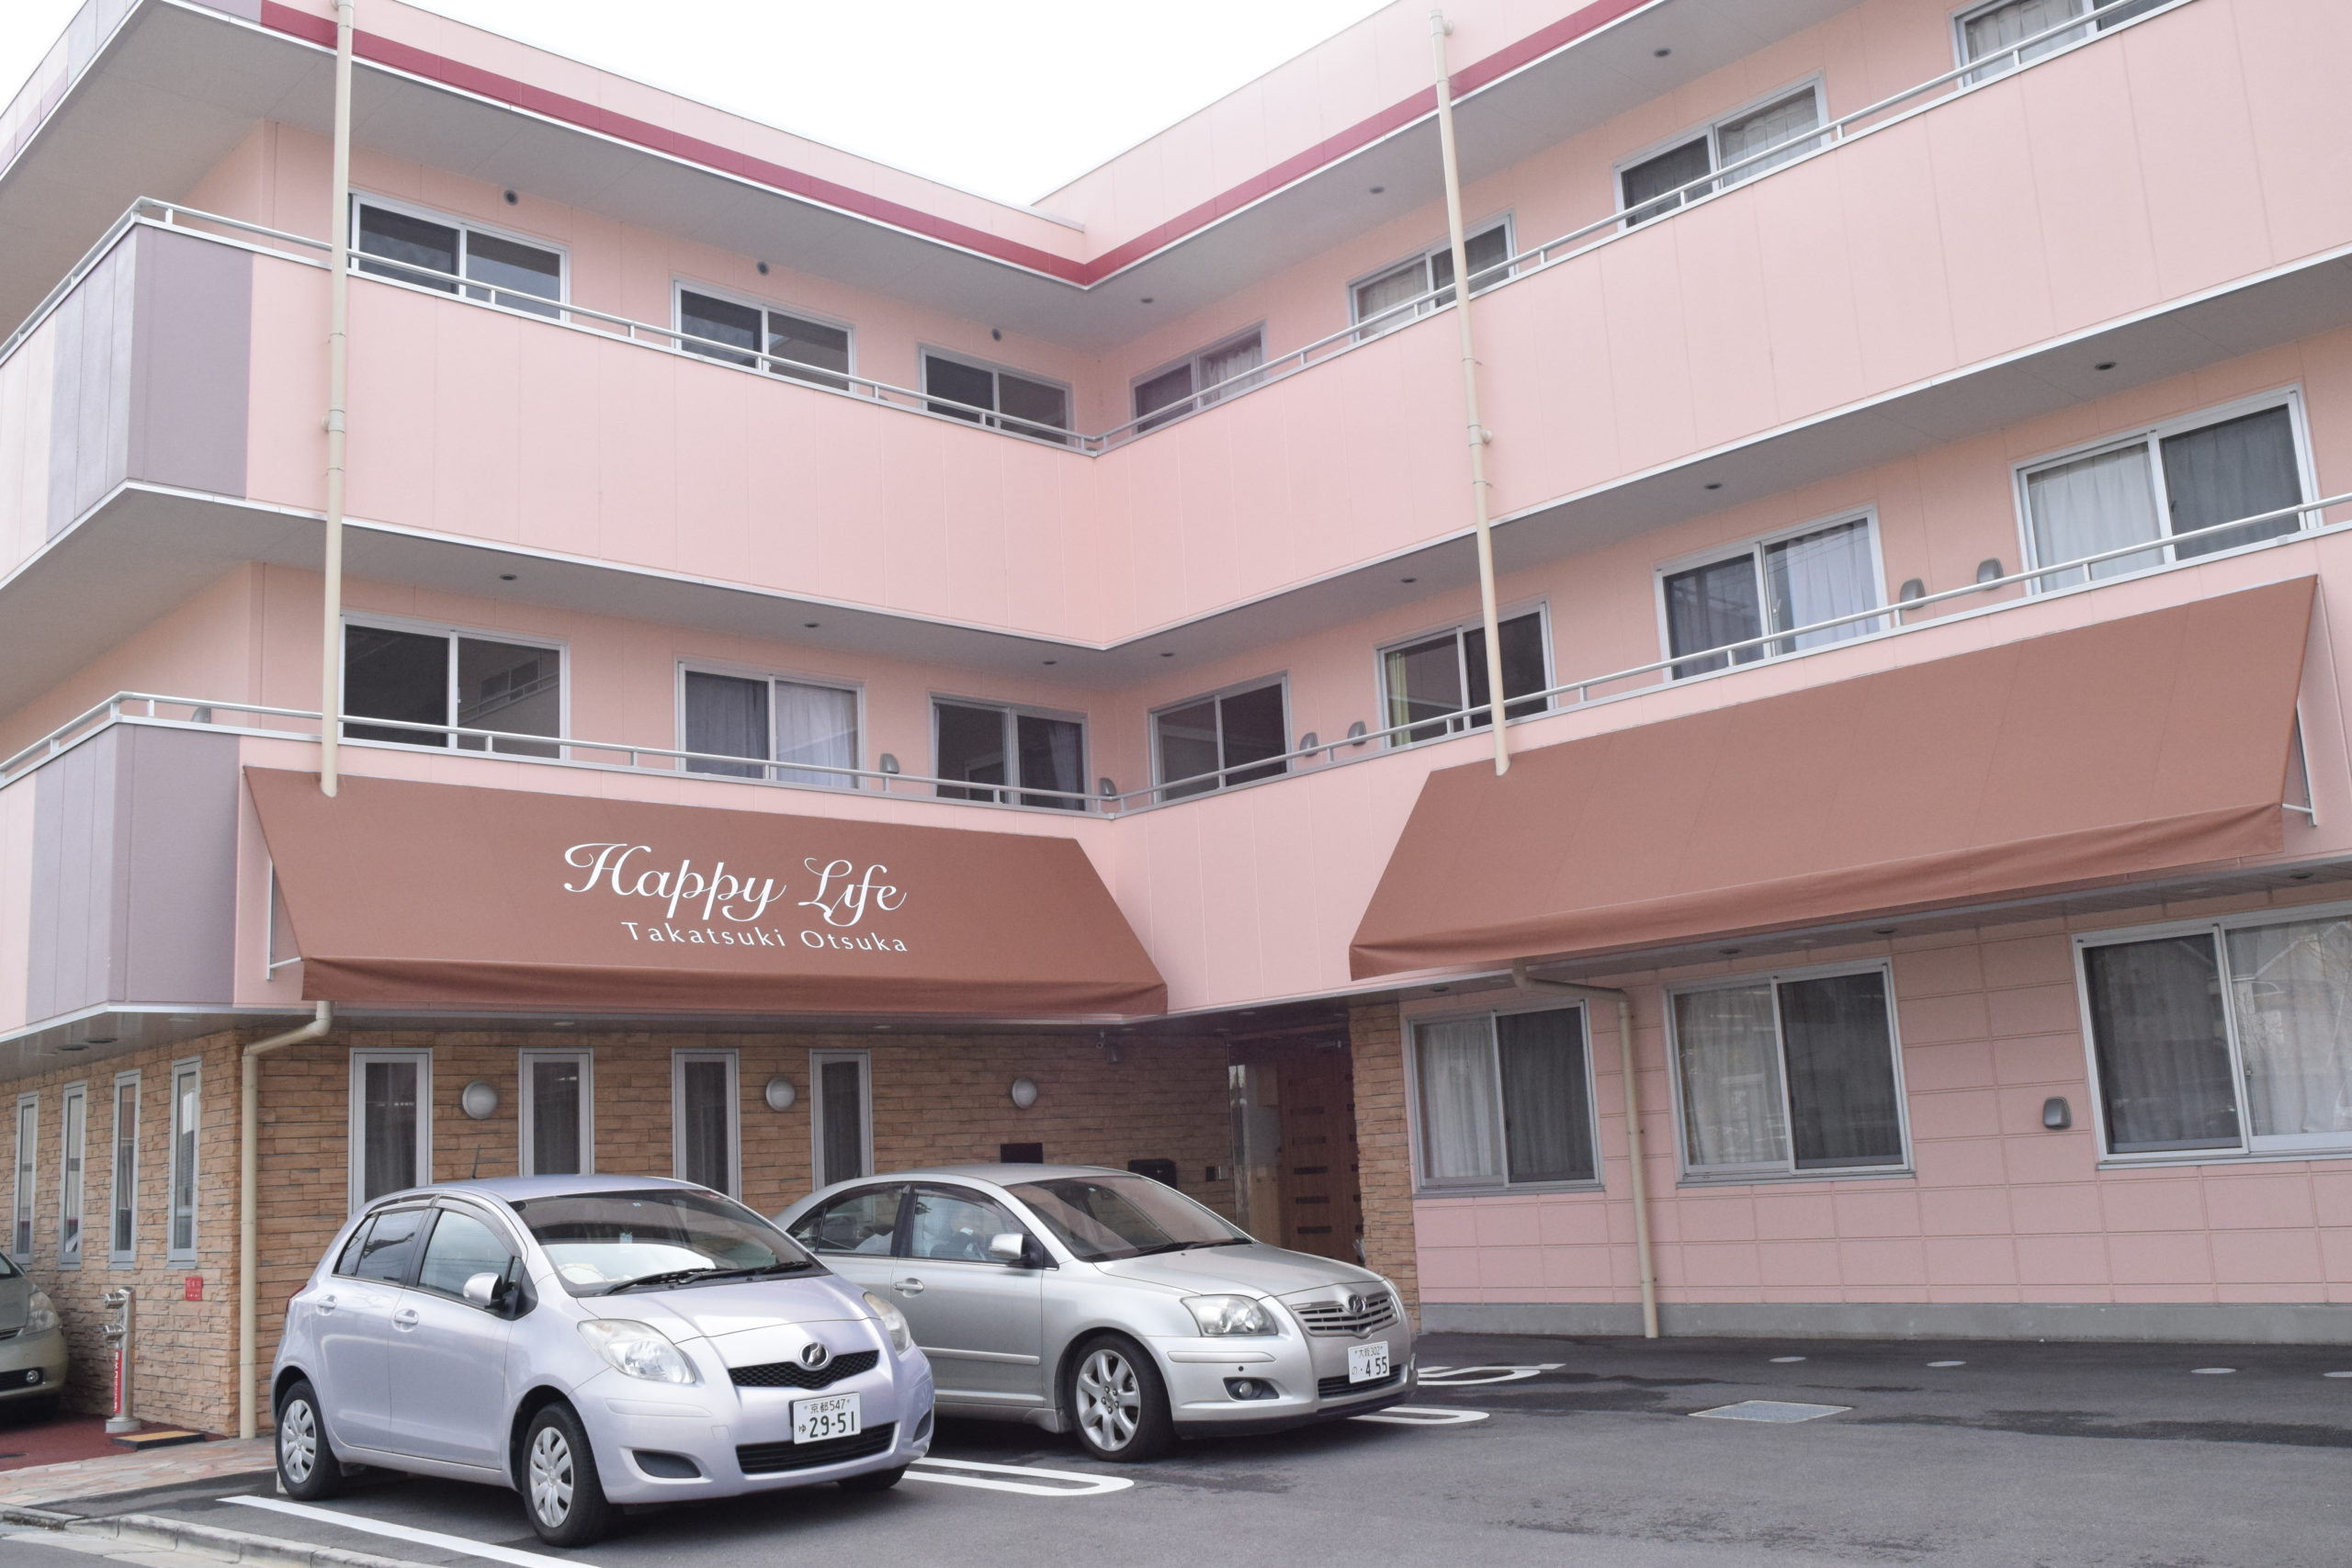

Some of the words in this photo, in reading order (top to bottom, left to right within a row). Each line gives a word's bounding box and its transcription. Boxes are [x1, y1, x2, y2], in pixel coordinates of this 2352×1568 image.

[564, 842, 786, 921] Happy
[797, 857, 907, 927] Life
[621, 921, 786, 947] Takatsuki
[800, 930, 909, 952] Otsuka
[809, 1411, 854, 1438] 29-51
